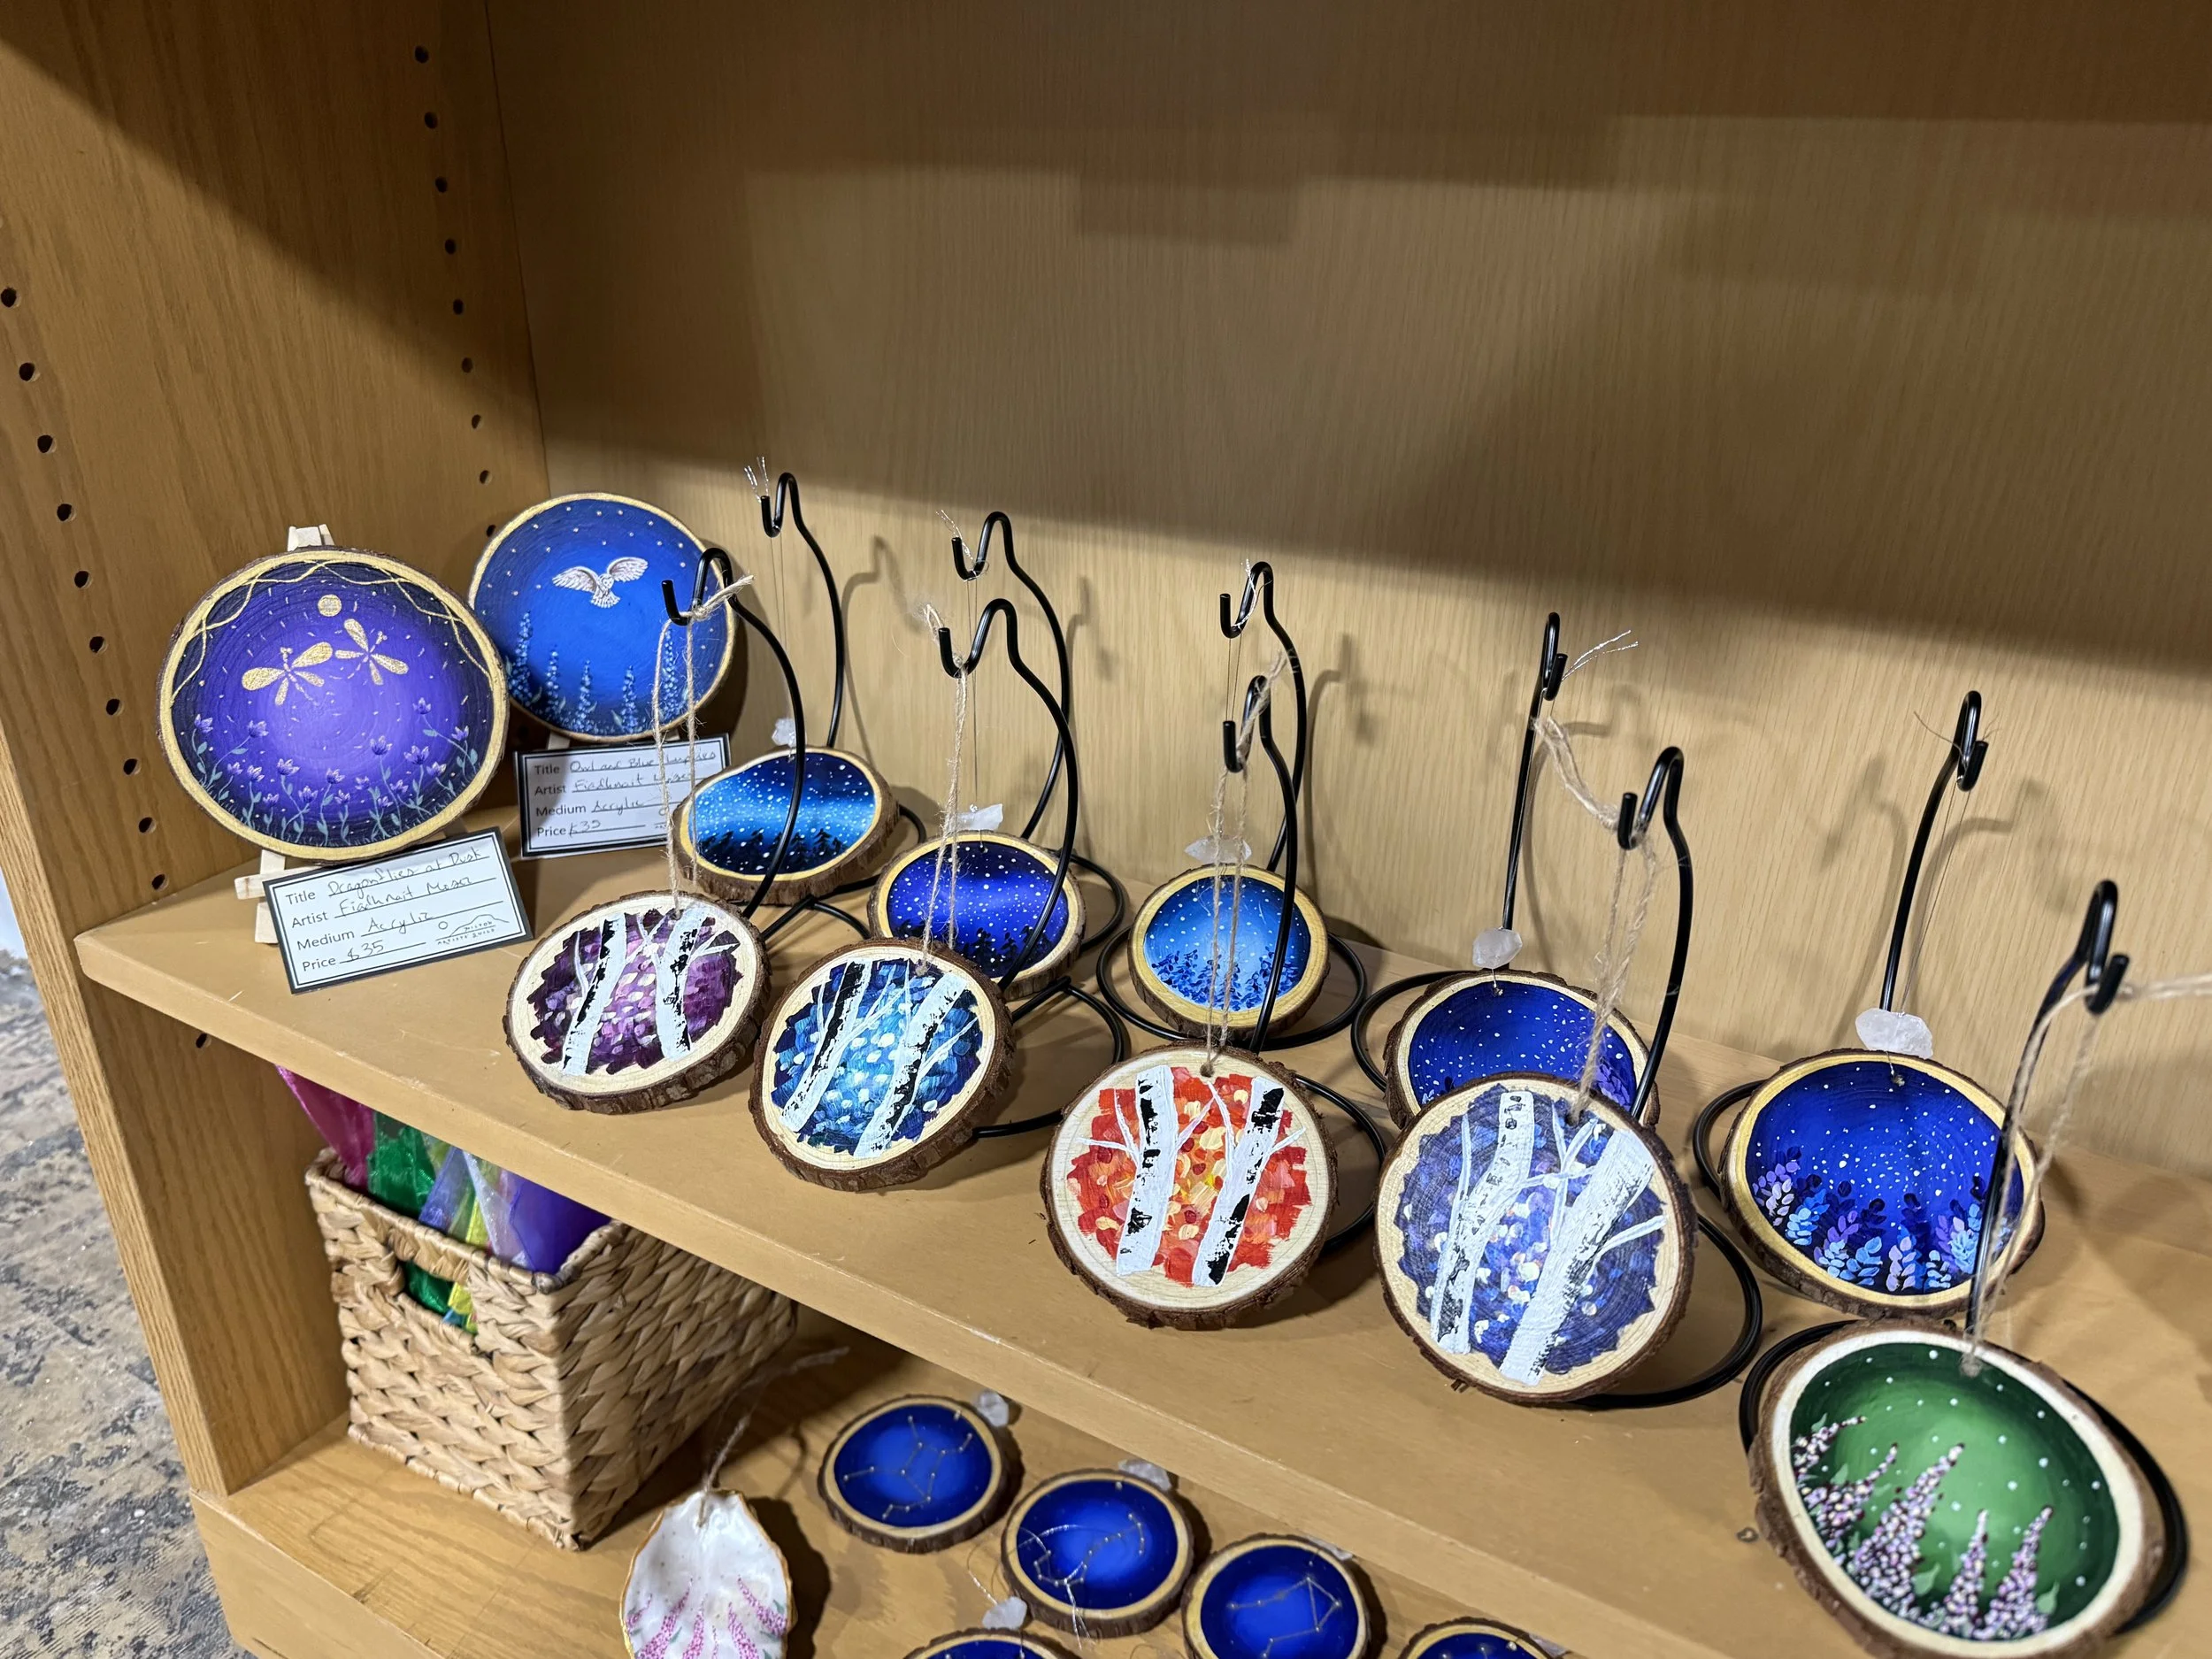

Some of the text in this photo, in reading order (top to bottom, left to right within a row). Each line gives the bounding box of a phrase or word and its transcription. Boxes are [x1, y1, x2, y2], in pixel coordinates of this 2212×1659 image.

[534, 764, 560, 775] Title
[534, 784, 566, 795] Artist
[536, 804, 587, 817] Medium
[537, 826, 566, 838] Price
[286, 846, 481, 906] Title Dragonflies at Dusk
[292, 910, 328, 929] Artist
[297, 911, 434, 950] Medium Acrylic
[302, 939, 384, 972] Price $35
